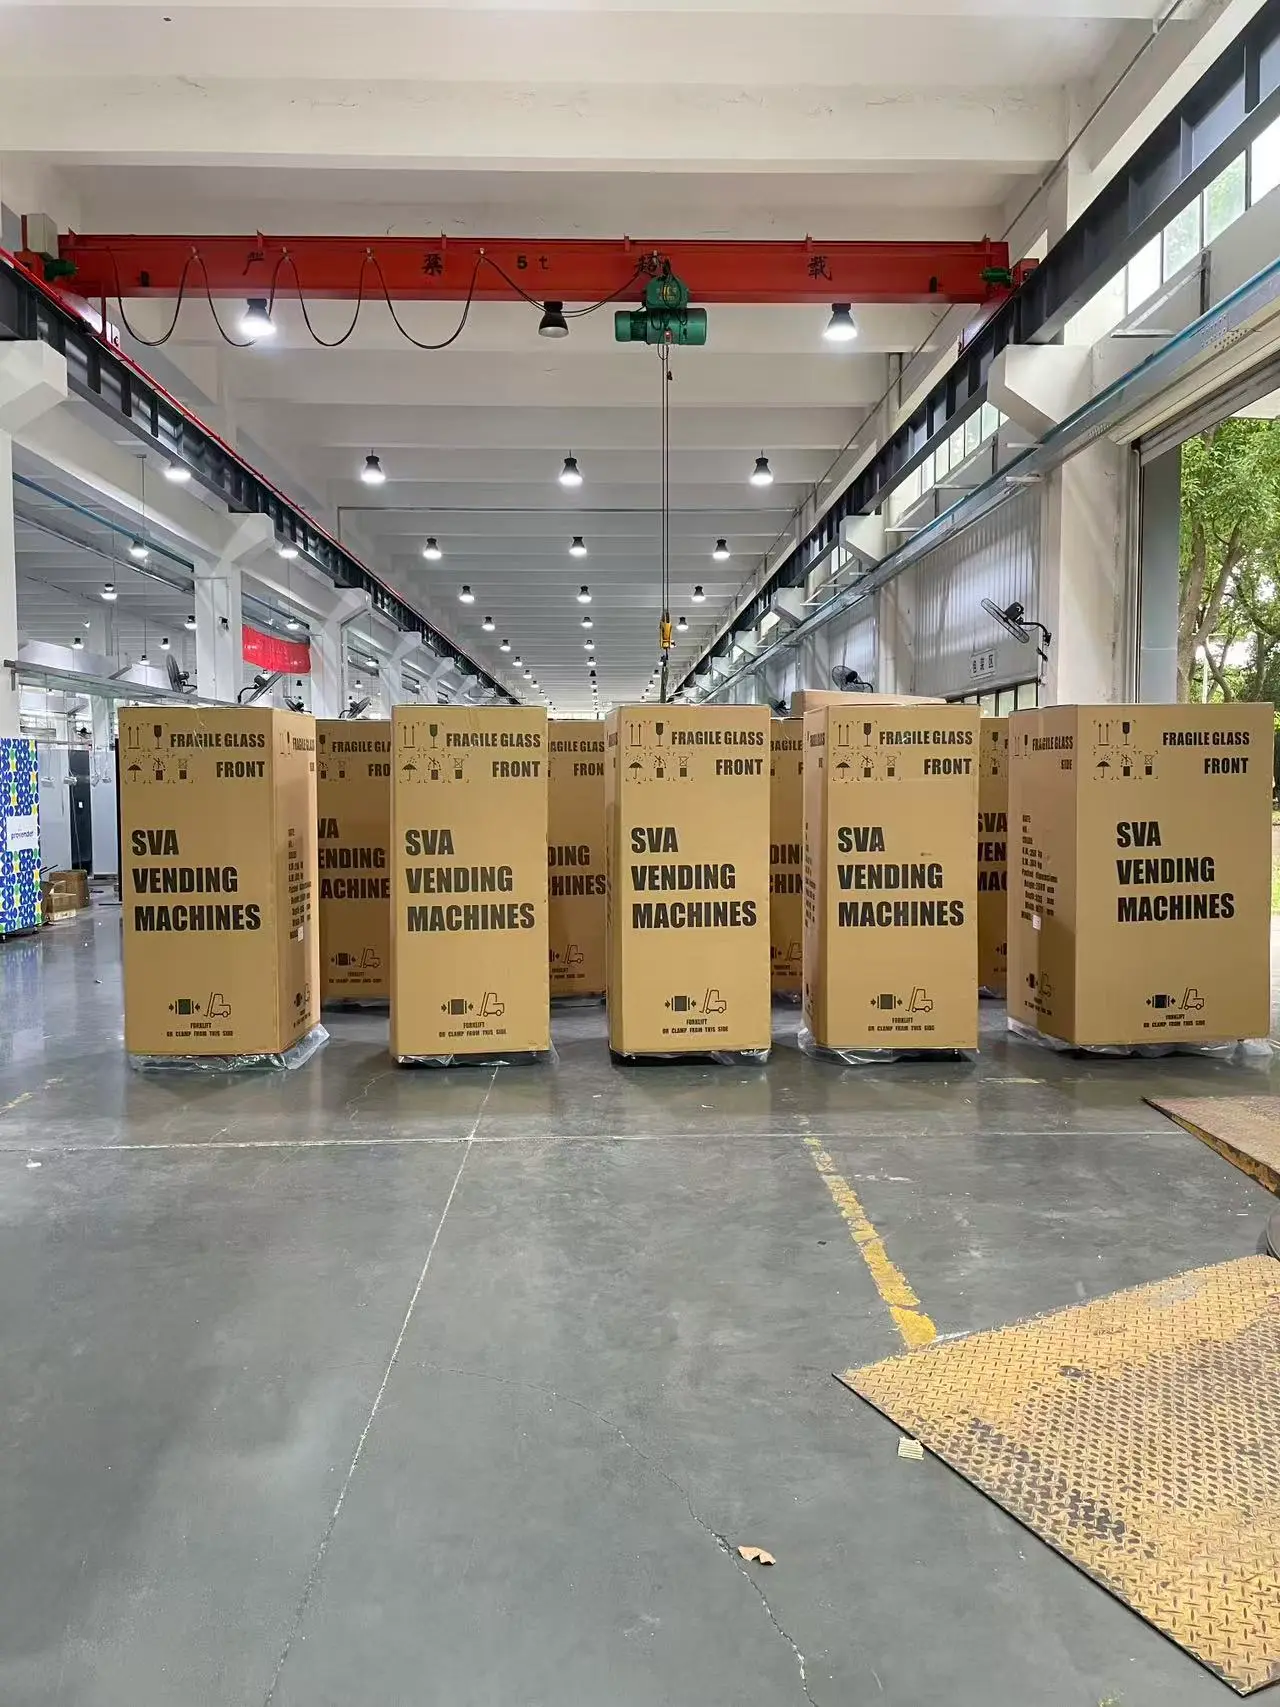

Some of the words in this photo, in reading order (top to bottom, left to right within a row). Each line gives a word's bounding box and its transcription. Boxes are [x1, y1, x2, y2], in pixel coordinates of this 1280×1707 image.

[170, 734, 221, 747] FRAGILE
[225, 733, 265, 747] GLASS
[332, 741, 372, 752] FRAGILE
[446, 733, 497, 747] FRAGILE
[500, 733, 541, 747] GLASS
[548, 741, 578, 752] AGILE
[672, 731, 722, 745] FRAGILE
[724, 731, 763, 745] GLASS
[880, 731, 930, 744] FRAGILE
[933, 731, 973, 744] GLASS
[1032, 737, 1054, 751] FRAGILE
[1055, 736, 1073, 749] GLASS
[1163, 732, 1209, 745] FRAGILE
[1212, 732, 1250, 745] GLASS
[216, 761, 265, 777] FRONT
[492, 761, 540, 777] FRONT
[716, 759, 763, 775] FRONT
[924, 758, 971, 775] FRONT
[1061, 759, 1072, 770] SIDE
[1204, 758, 1249, 774] FRONT
[132, 829, 179, 855] SVA
[406, 830, 454, 856] SVA
[631, 827, 678, 853] SVA
[838, 827, 885, 852] SVA
[1117, 822, 1162, 847] SVA
[133, 867, 238, 893] VENDING
[406, 866, 512, 893] VENDING
[631, 864, 735, 891] VENDING
[838, 863, 943, 889] VENDING
[1116, 857, 1215, 885] VENDING
[548, 875, 606, 896] HINES
[135, 904, 261, 931] MACHINES
[408, 903, 535, 932] MACHINES
[633, 901, 757, 929] MACHINES
[839, 900, 964, 927] MACHINES
[1118, 893, 1234, 922] MACHINES
